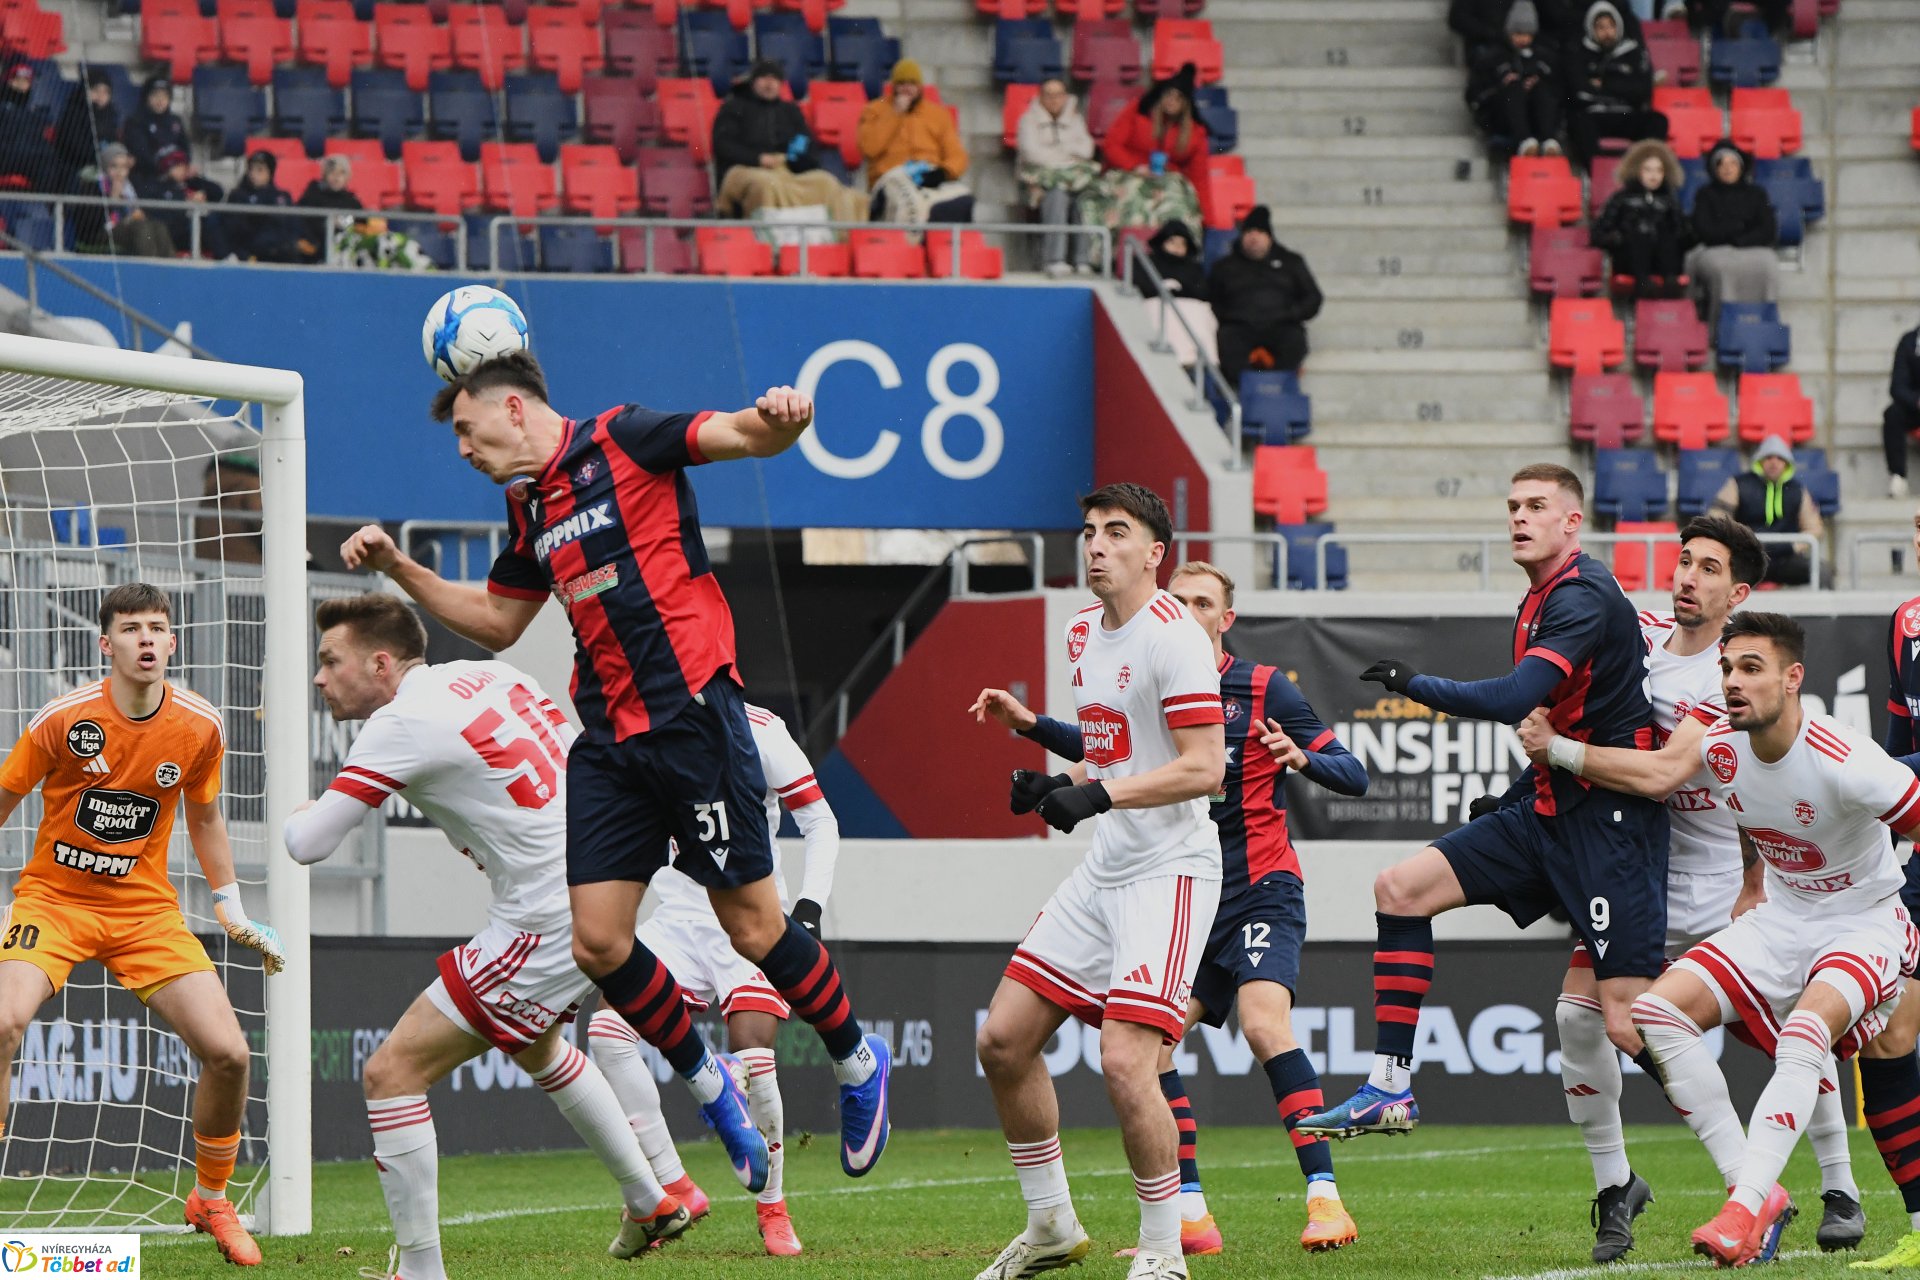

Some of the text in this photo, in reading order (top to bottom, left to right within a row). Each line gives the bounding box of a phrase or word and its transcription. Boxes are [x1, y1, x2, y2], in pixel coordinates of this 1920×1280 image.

[1343, 116, 1367, 136] 12
[1362, 187, 1384, 207] 11
[1397, 328, 1424, 349] 09
[1435, 477, 1462, 498] 07
[80, 730, 100, 741] fizz
[1079, 717, 1123, 736] master
[81, 739, 100, 752] liga
[1085, 733, 1115, 754] good
[1717, 754, 1734, 766] fizz
[87, 797, 151, 818] master
[93, 814, 137, 831] good
[694, 801, 730, 842] 31
[1589, 896, 1610, 932] 9
[3, 923, 40, 950] 30
[1241, 922, 1271, 950] 12
